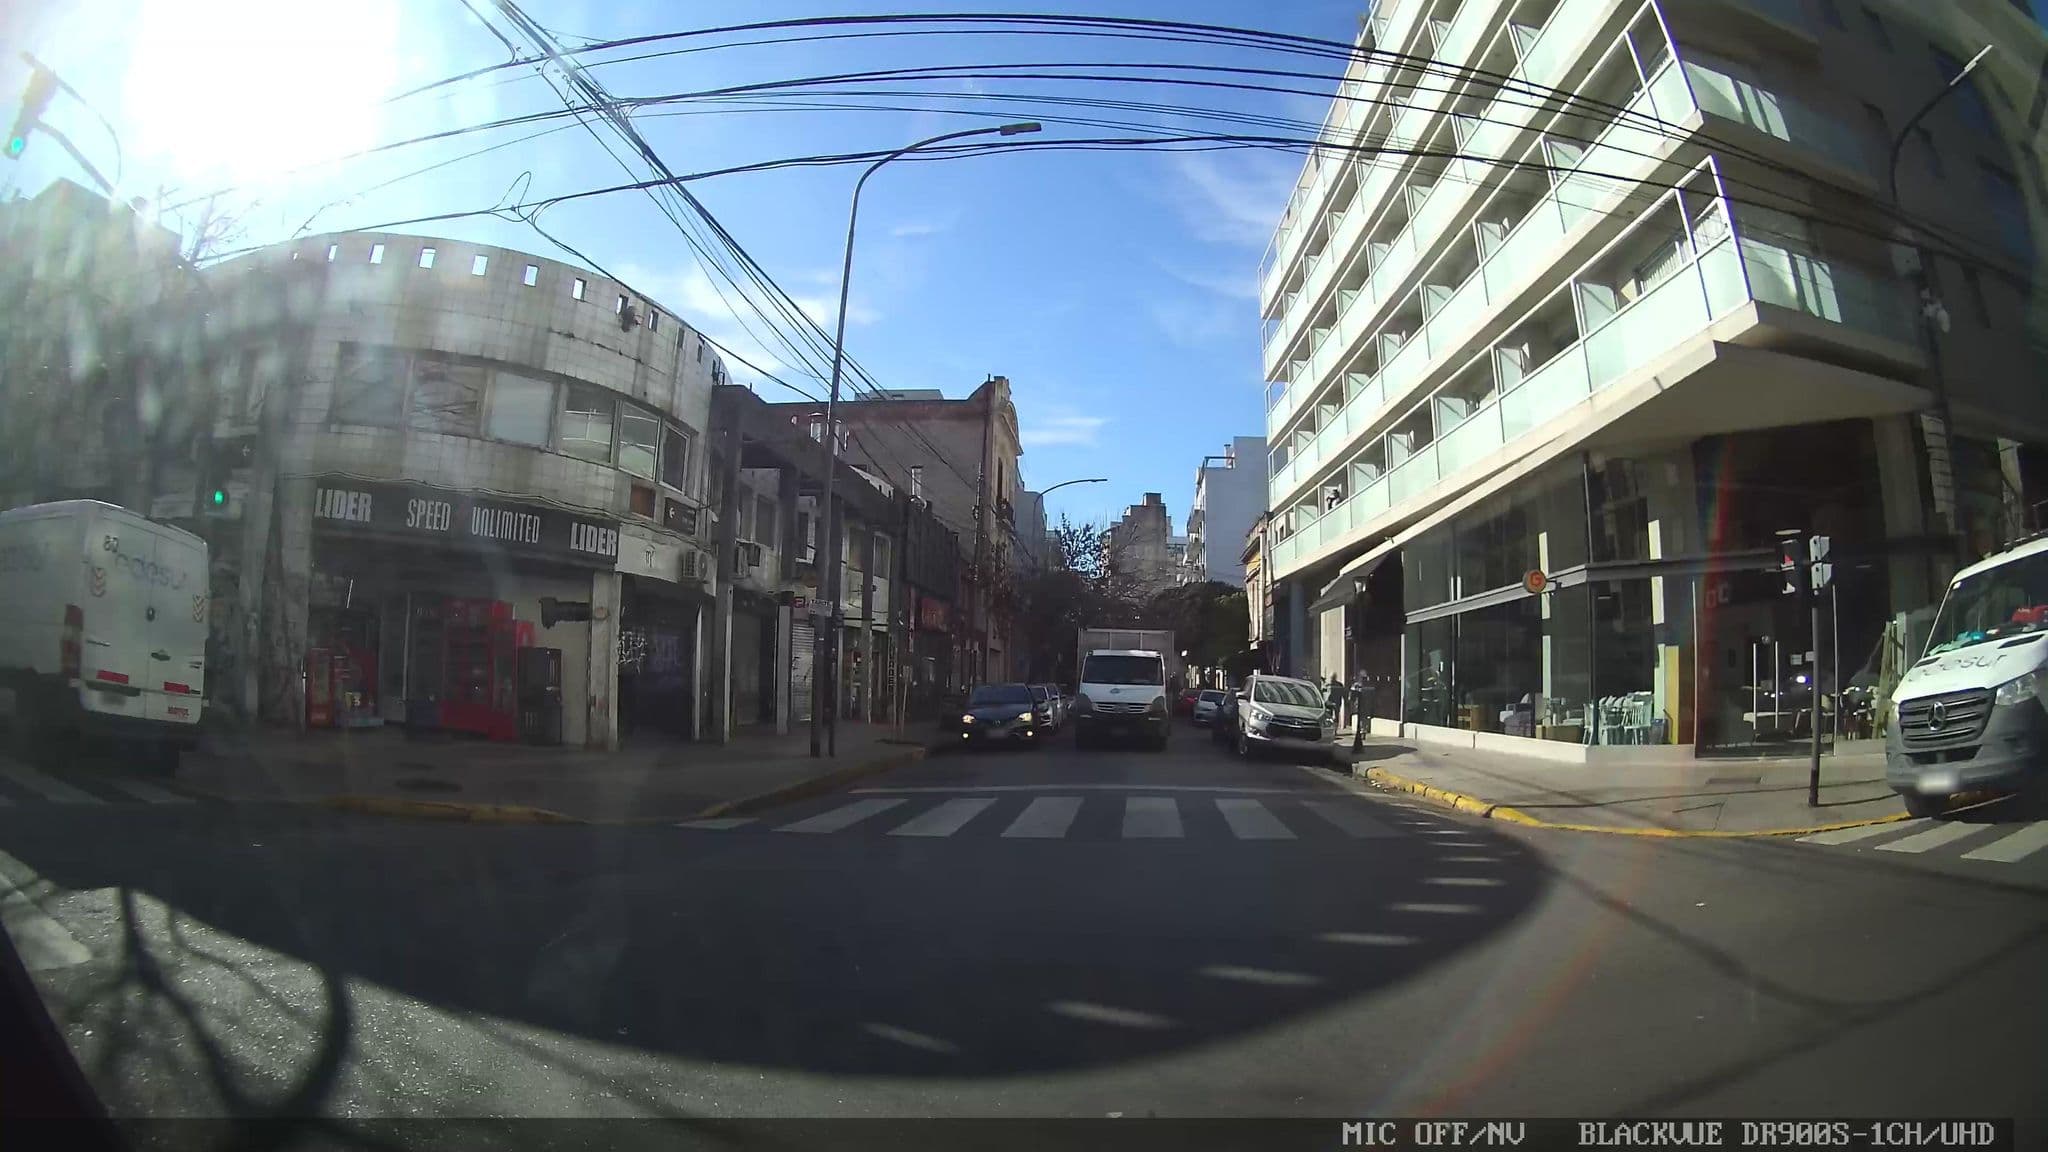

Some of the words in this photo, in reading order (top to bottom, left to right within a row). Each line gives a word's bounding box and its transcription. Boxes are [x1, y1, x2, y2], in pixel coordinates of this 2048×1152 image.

[315, 488, 371, 523] LIDER
[406, 498, 451, 532] SPEED
[471, 506, 532, 543] UNLIMITED
[571, 523, 617, 557] LIDER
